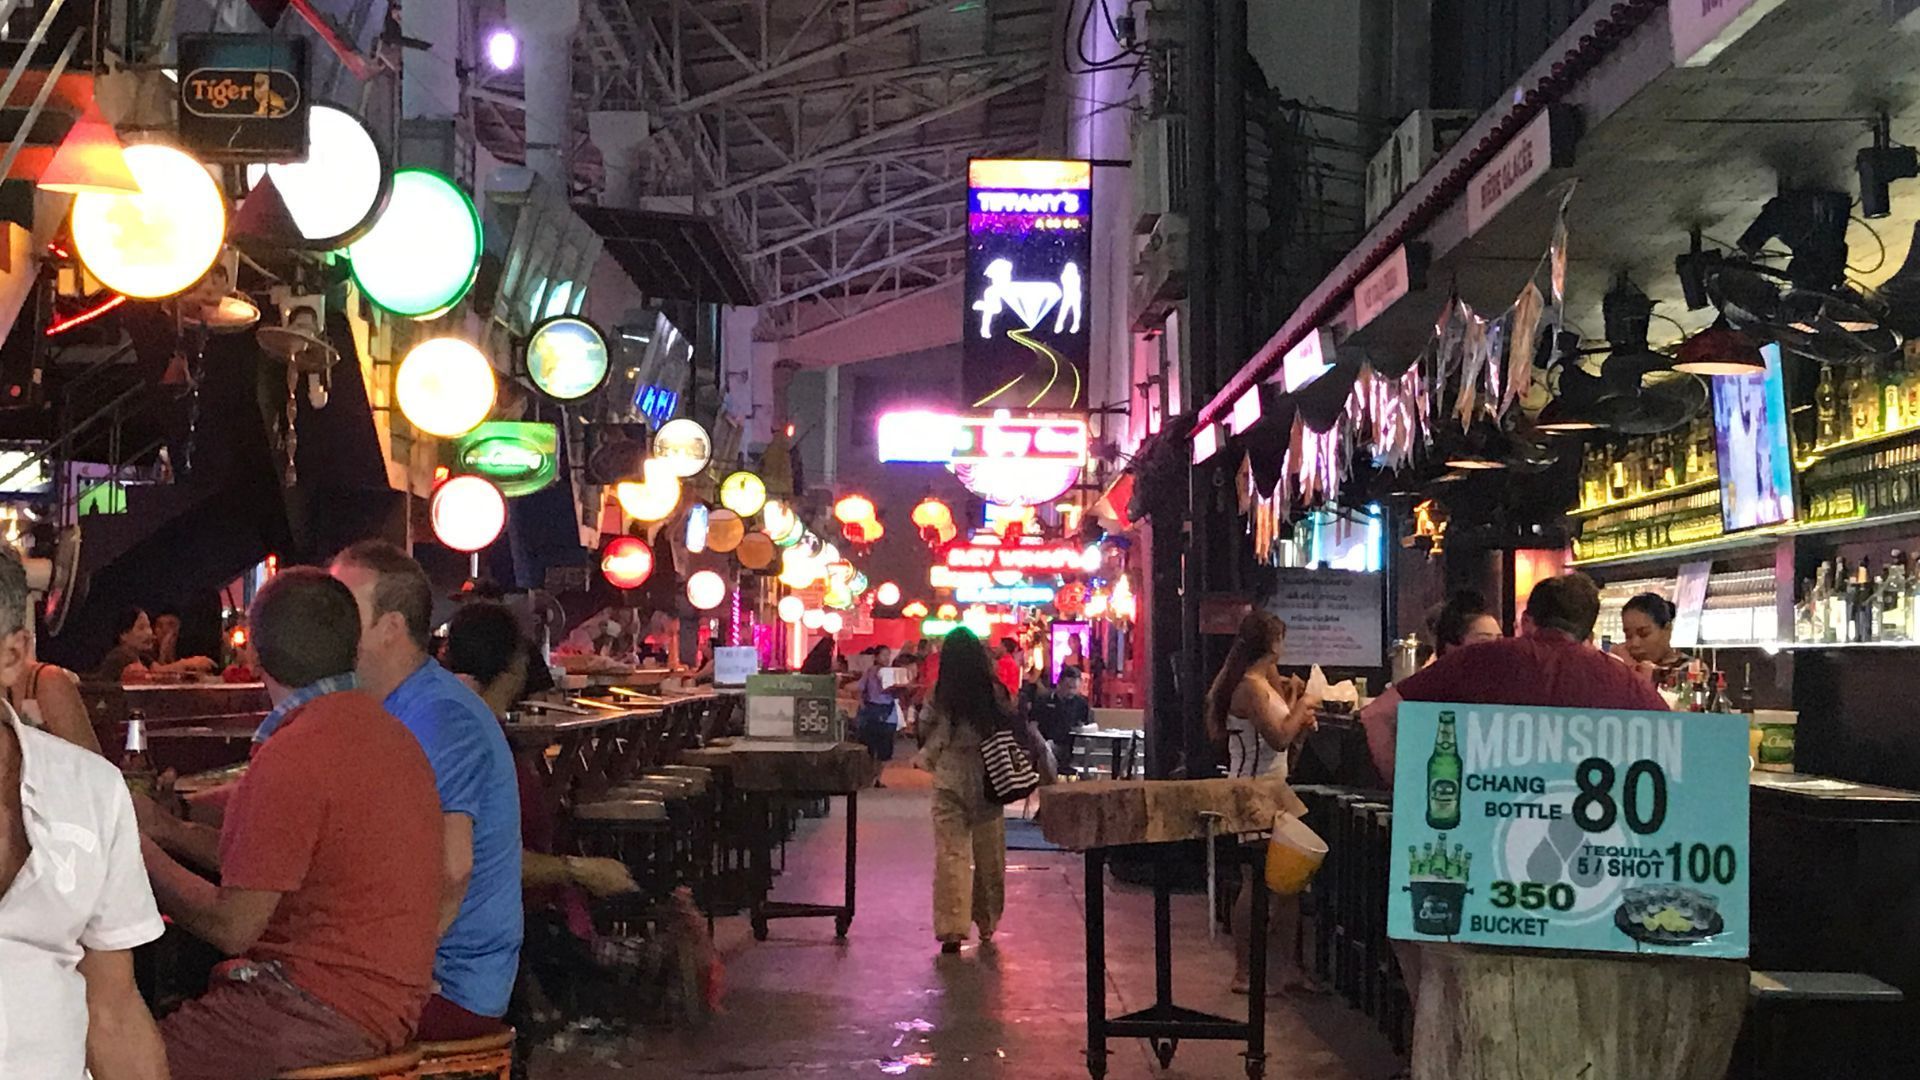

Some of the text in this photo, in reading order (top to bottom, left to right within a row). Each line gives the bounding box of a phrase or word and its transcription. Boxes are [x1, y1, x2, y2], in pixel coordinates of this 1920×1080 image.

[191, 78, 252, 109] Tiger
[976, 191, 1080, 213] TIFFANY'S
[1465, 710, 1683, 783] MONSOON
[1465, 773, 1546, 795] CHANG
[1572, 757, 1668, 835] 80
[1484, 801, 1563, 820] BOTTLE
[1582, 845, 1661, 858] TEQUILA
[1607, 858, 1665, 878] SHOT
[1665, 842, 1736, 885] 100
[1489, 880, 1576, 912] 350
[1469, 914, 1549, 937] BUCKET
